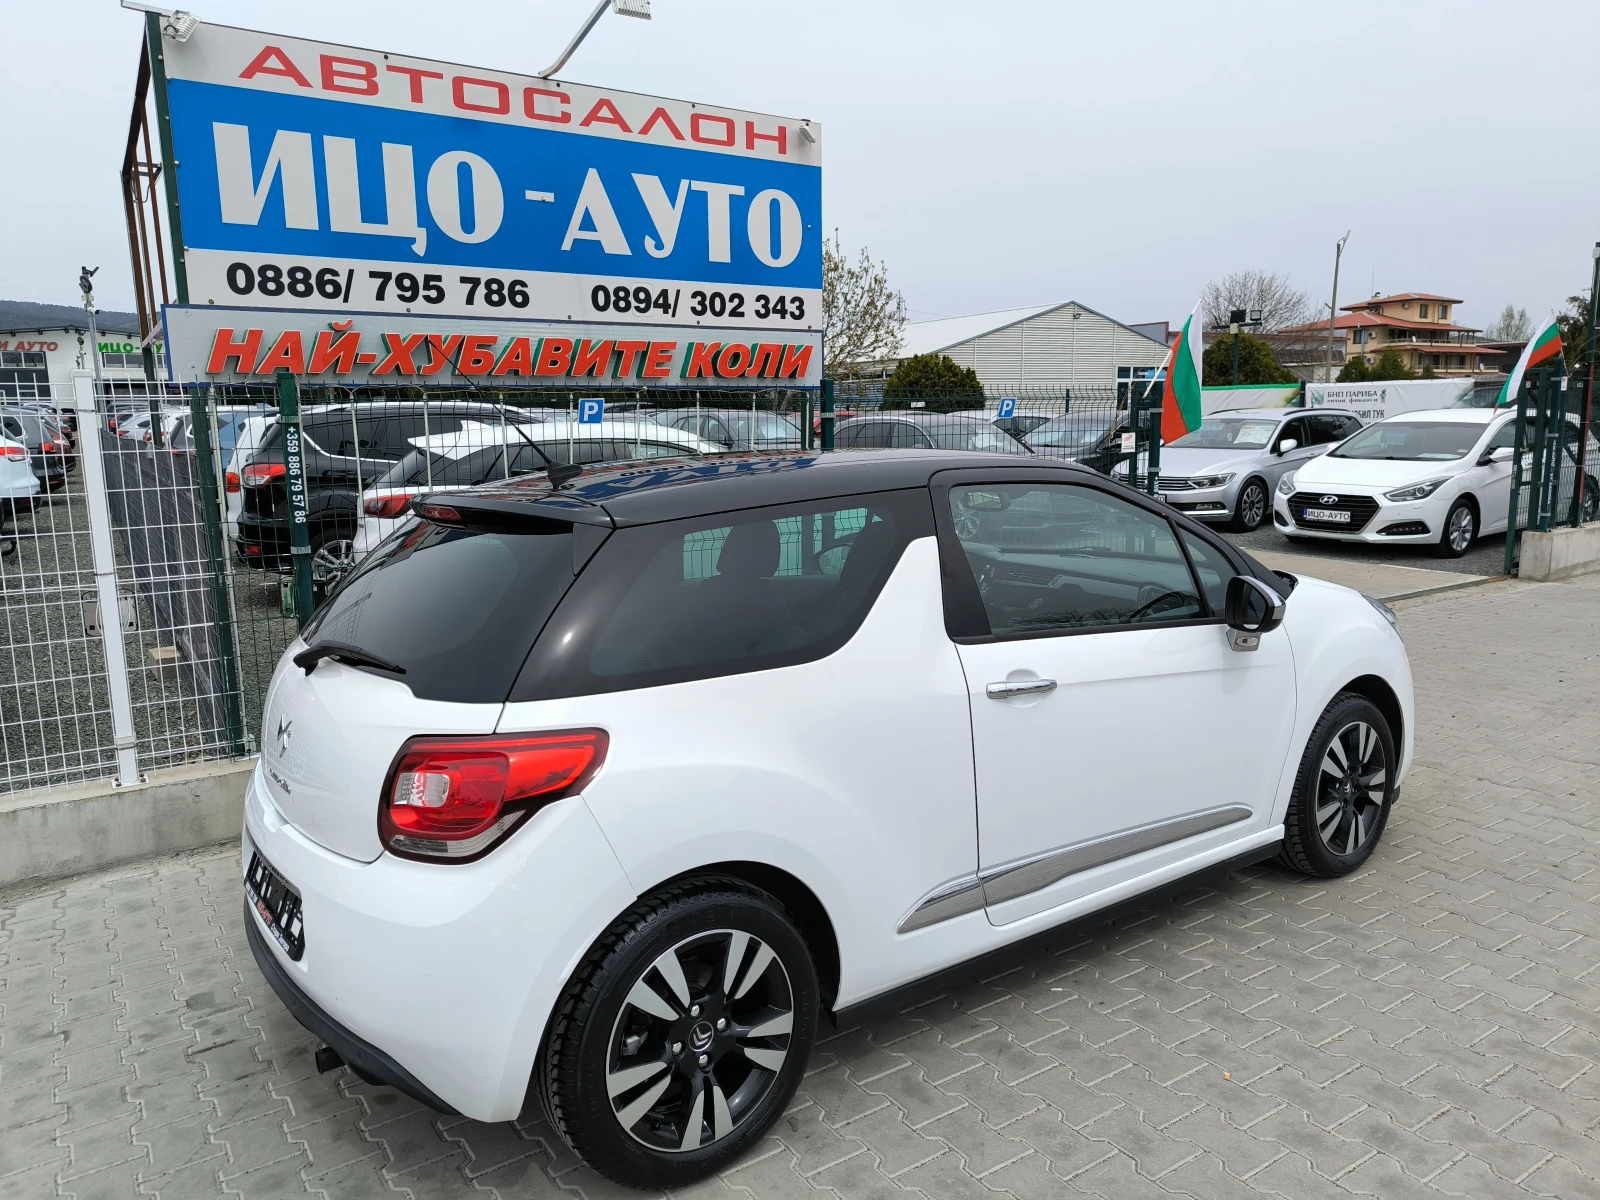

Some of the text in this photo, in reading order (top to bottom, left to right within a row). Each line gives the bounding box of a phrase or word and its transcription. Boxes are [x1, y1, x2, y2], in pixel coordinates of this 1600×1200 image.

[238, 45, 787, 155] АВТОСАЛОН
[212, 121, 504, 257] ИЦО
[561, 167, 802, 268] АУТО
[226, 262, 530, 308] 0886/ 795 786
[591, 285, 806, 320] 0894/ 302 343
[14, 341, 58, 352] АУТО
[206, 319, 814, 379] НАЙ-ХУБАВИТЕ КОЛИ
[583, 402, 598, 421] P
[1002, 401, 1013, 415] P
[1345, 390, 1378, 398] ПАРИБА
[287, 426, 306, 523] +359 886 79 57 86
[1308, 510, 1350, 520] ИЦО-АУТО
